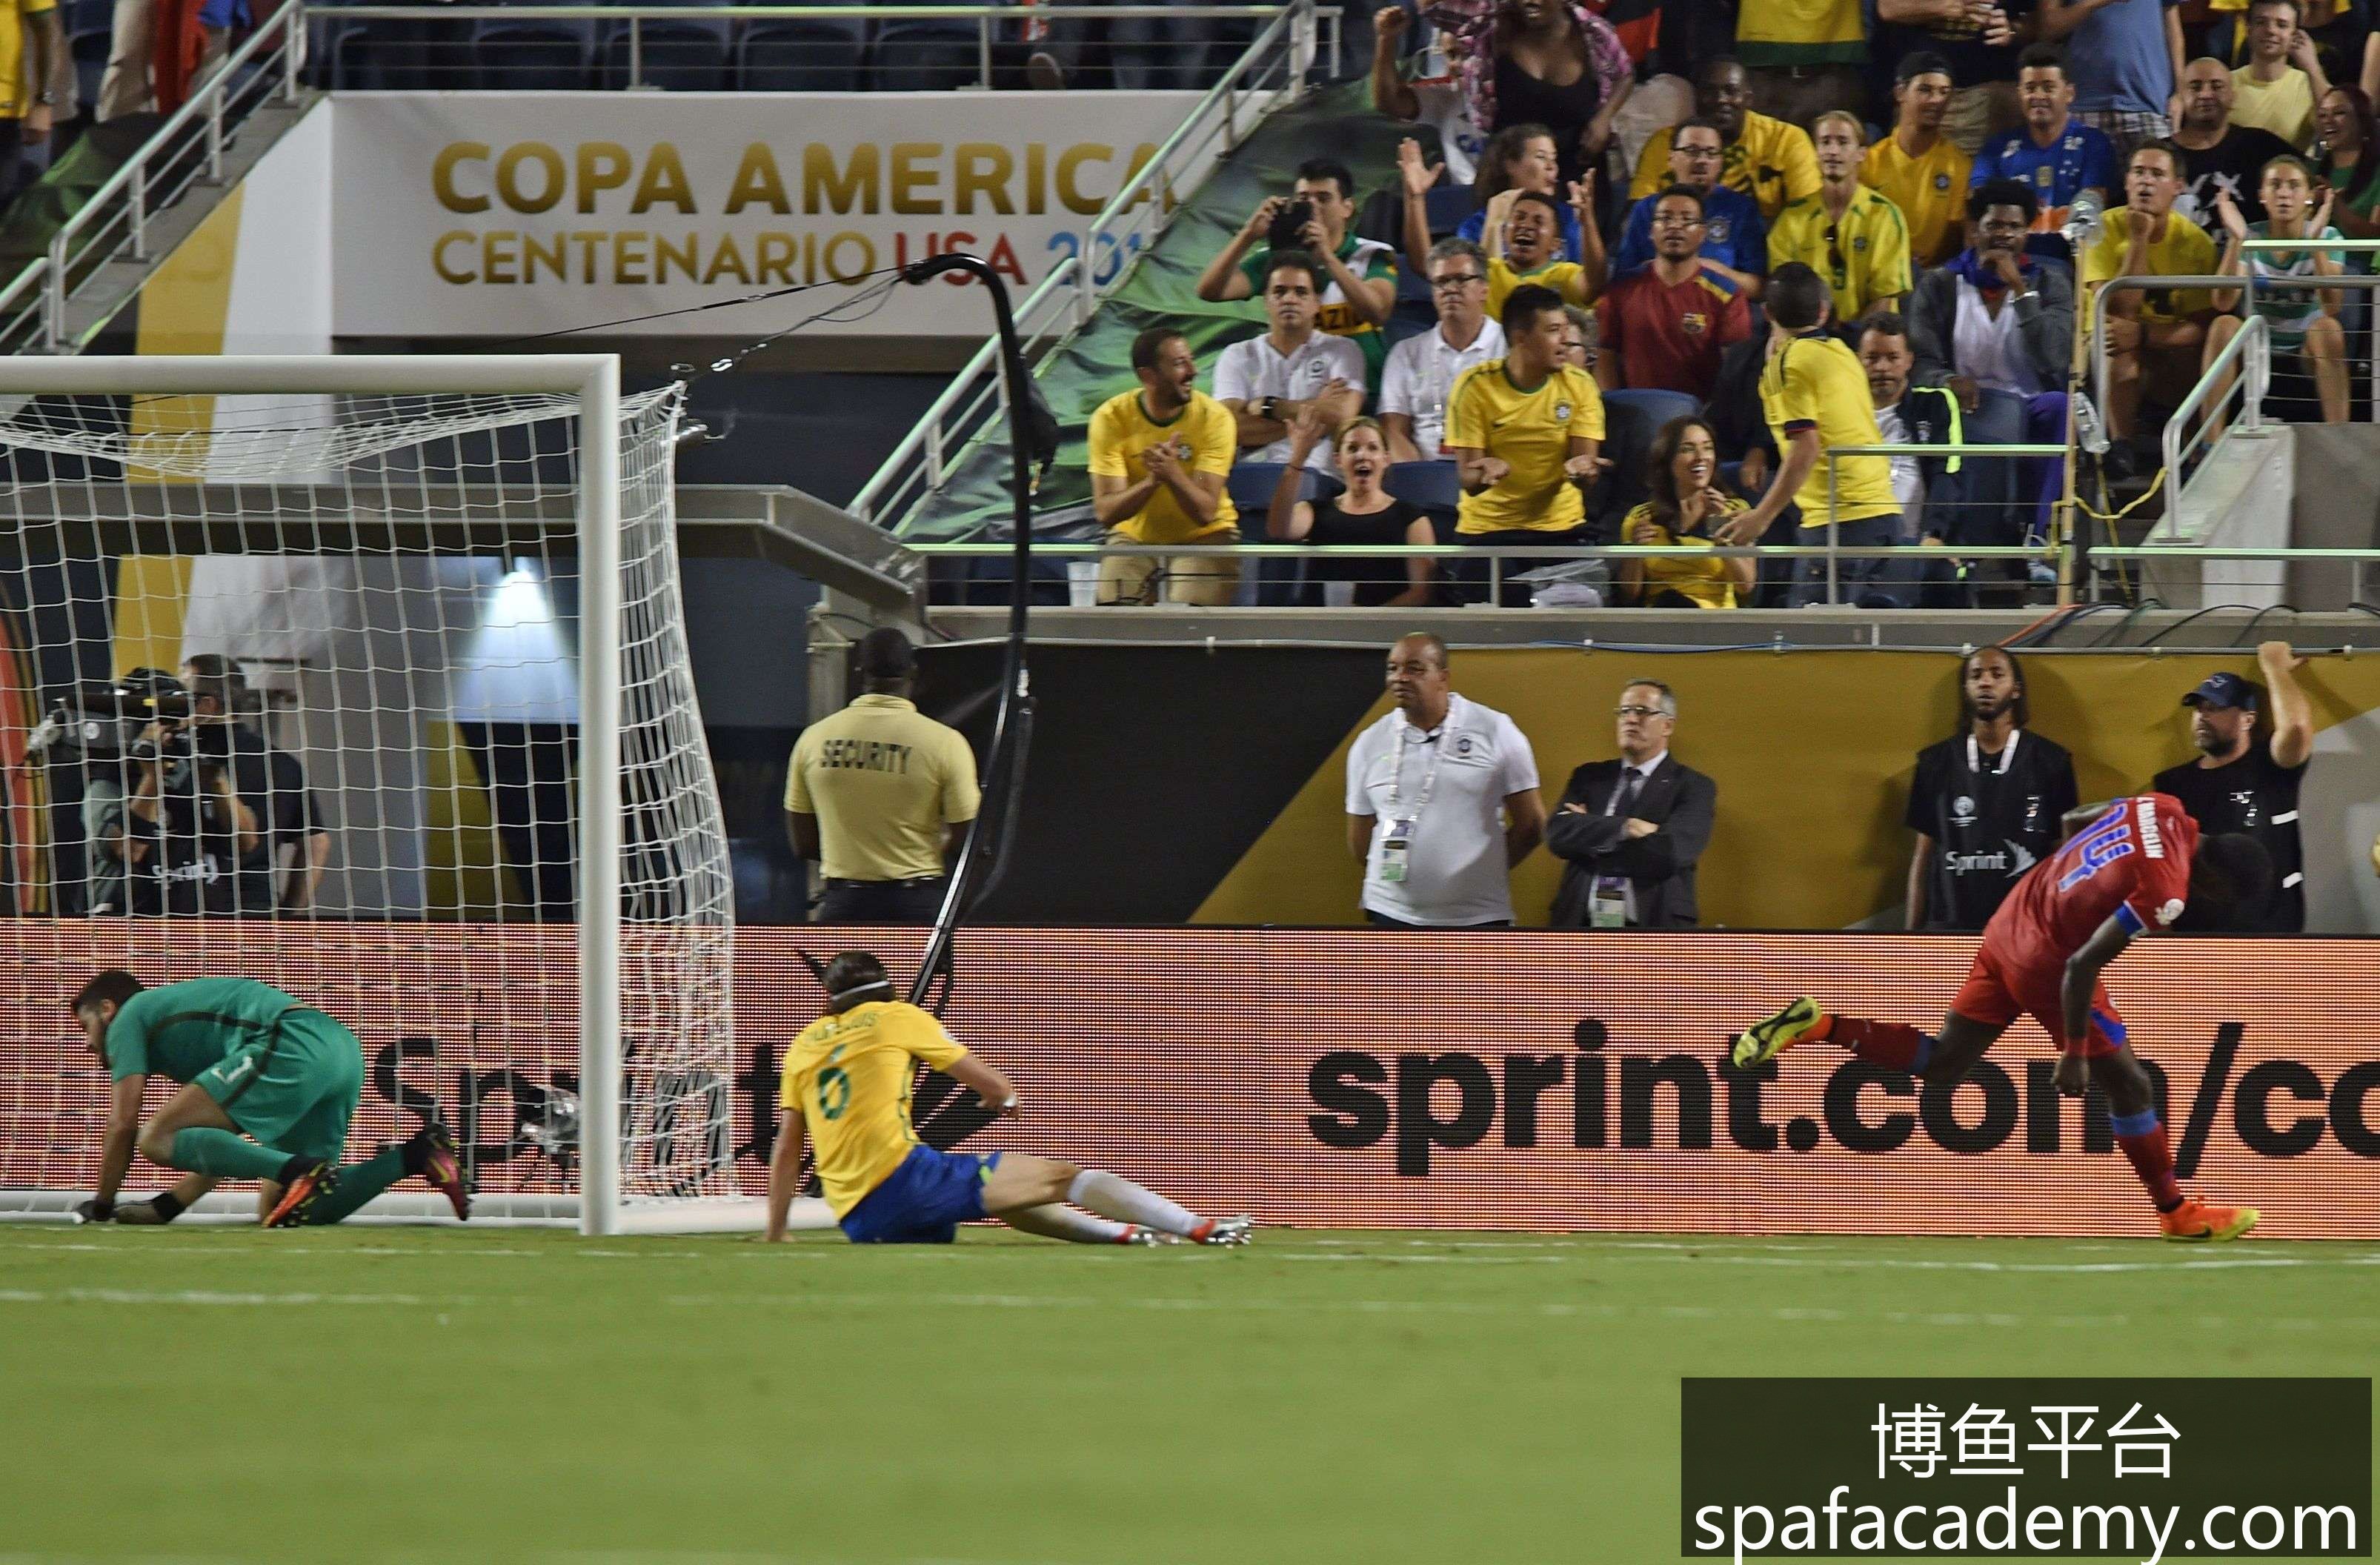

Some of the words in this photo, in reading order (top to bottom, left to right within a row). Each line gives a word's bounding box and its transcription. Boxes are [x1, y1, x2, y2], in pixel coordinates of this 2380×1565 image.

[432, 142, 696, 215] COPA
[725, 142, 1177, 215] AMERICA
[432, 230, 877, 286] CENTENARIO
[894, 230, 1028, 286] USA
[820, 739, 913, 775] SECURITY
[1945, 851, 2007, 876] Sprint
[817, 1043, 851, 1121] 6
